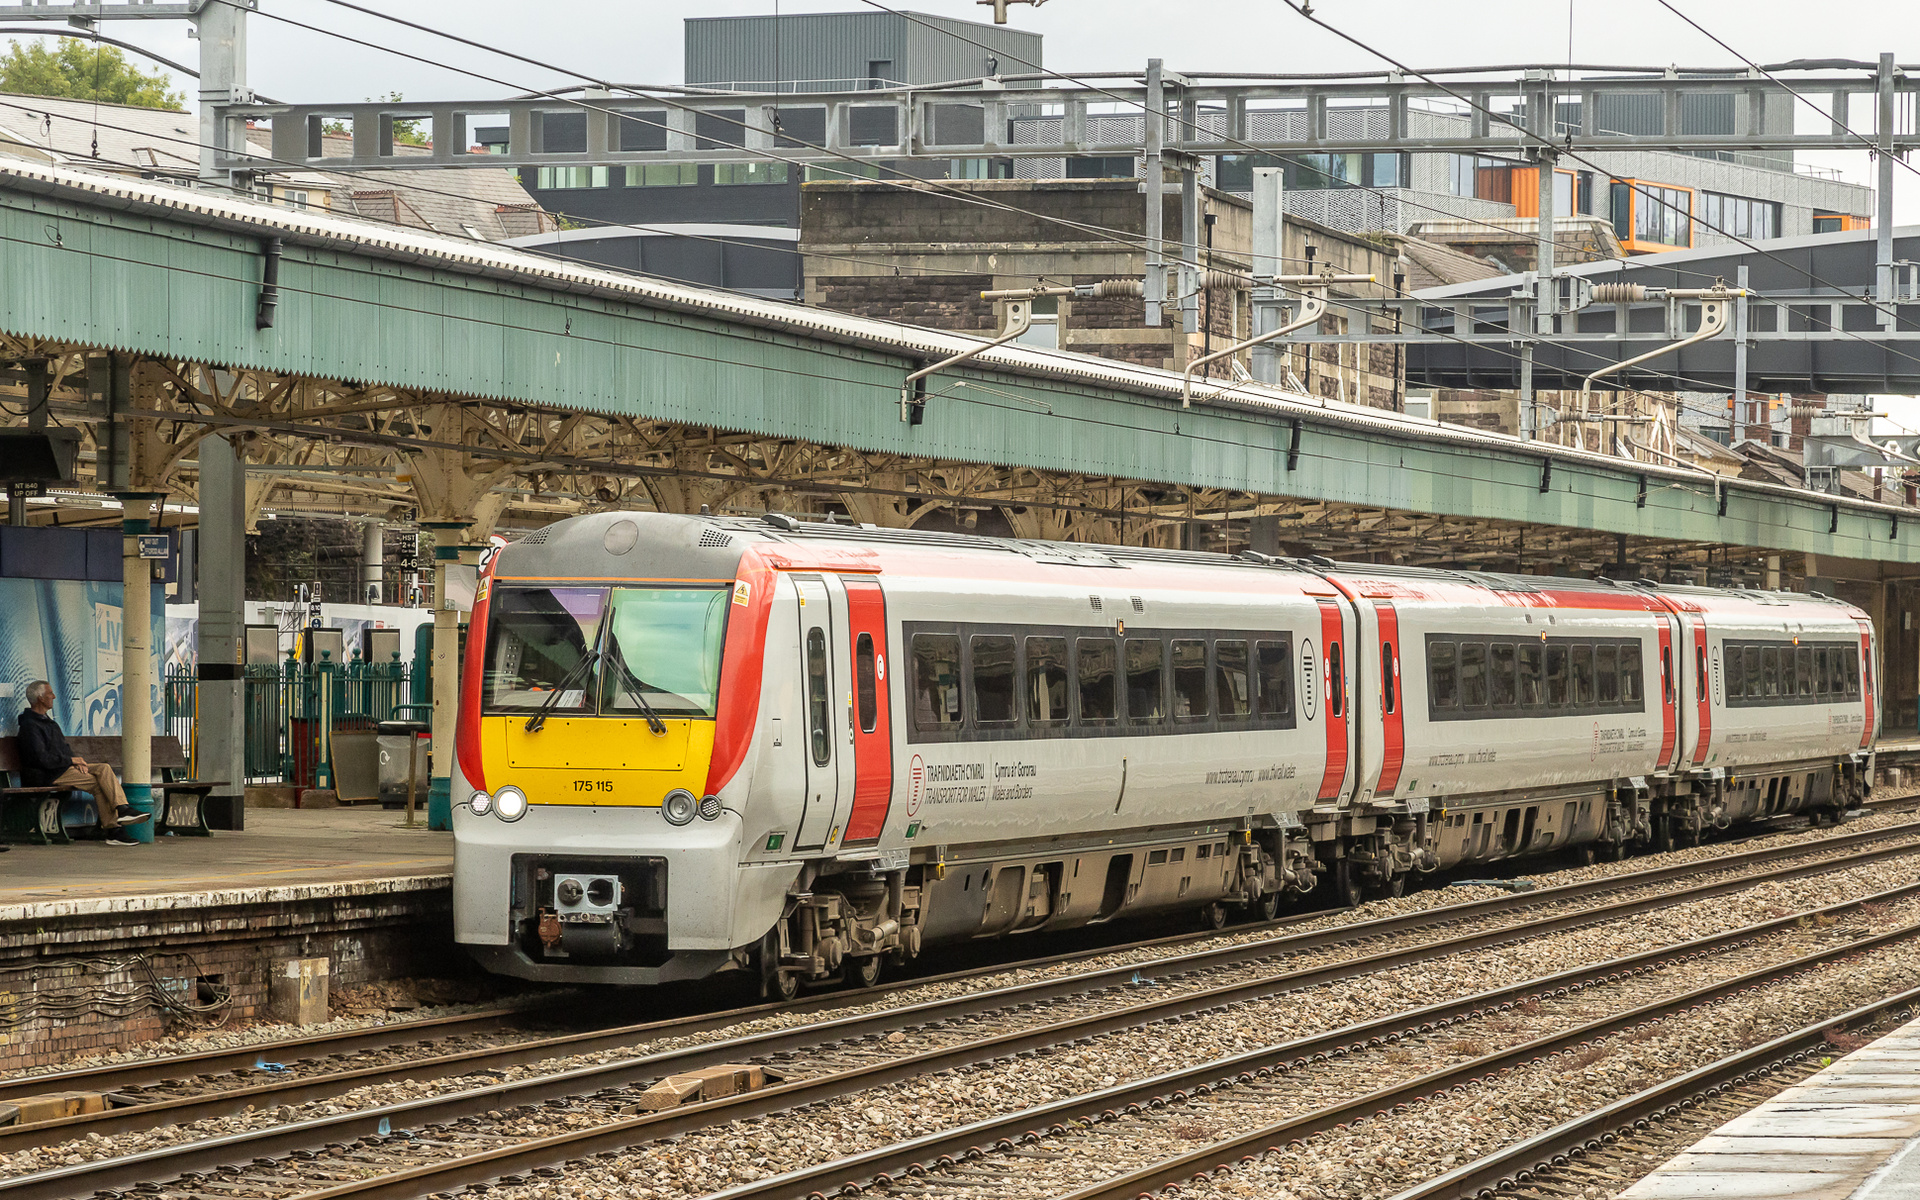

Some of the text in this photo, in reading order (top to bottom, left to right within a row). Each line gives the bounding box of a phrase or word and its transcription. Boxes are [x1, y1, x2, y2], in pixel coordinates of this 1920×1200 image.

[402, 541, 416, 549] 2+4
[400, 558, 418, 568] 4-6
[966, 763, 985, 780] CYMRU
[994, 762, 1011, 782] Cymru
[572, 780, 614, 792] 175 115
[925, 785, 987, 804] TRANSPORT FOR WALES
[992, 784, 1033, 801] Wales and Borders
